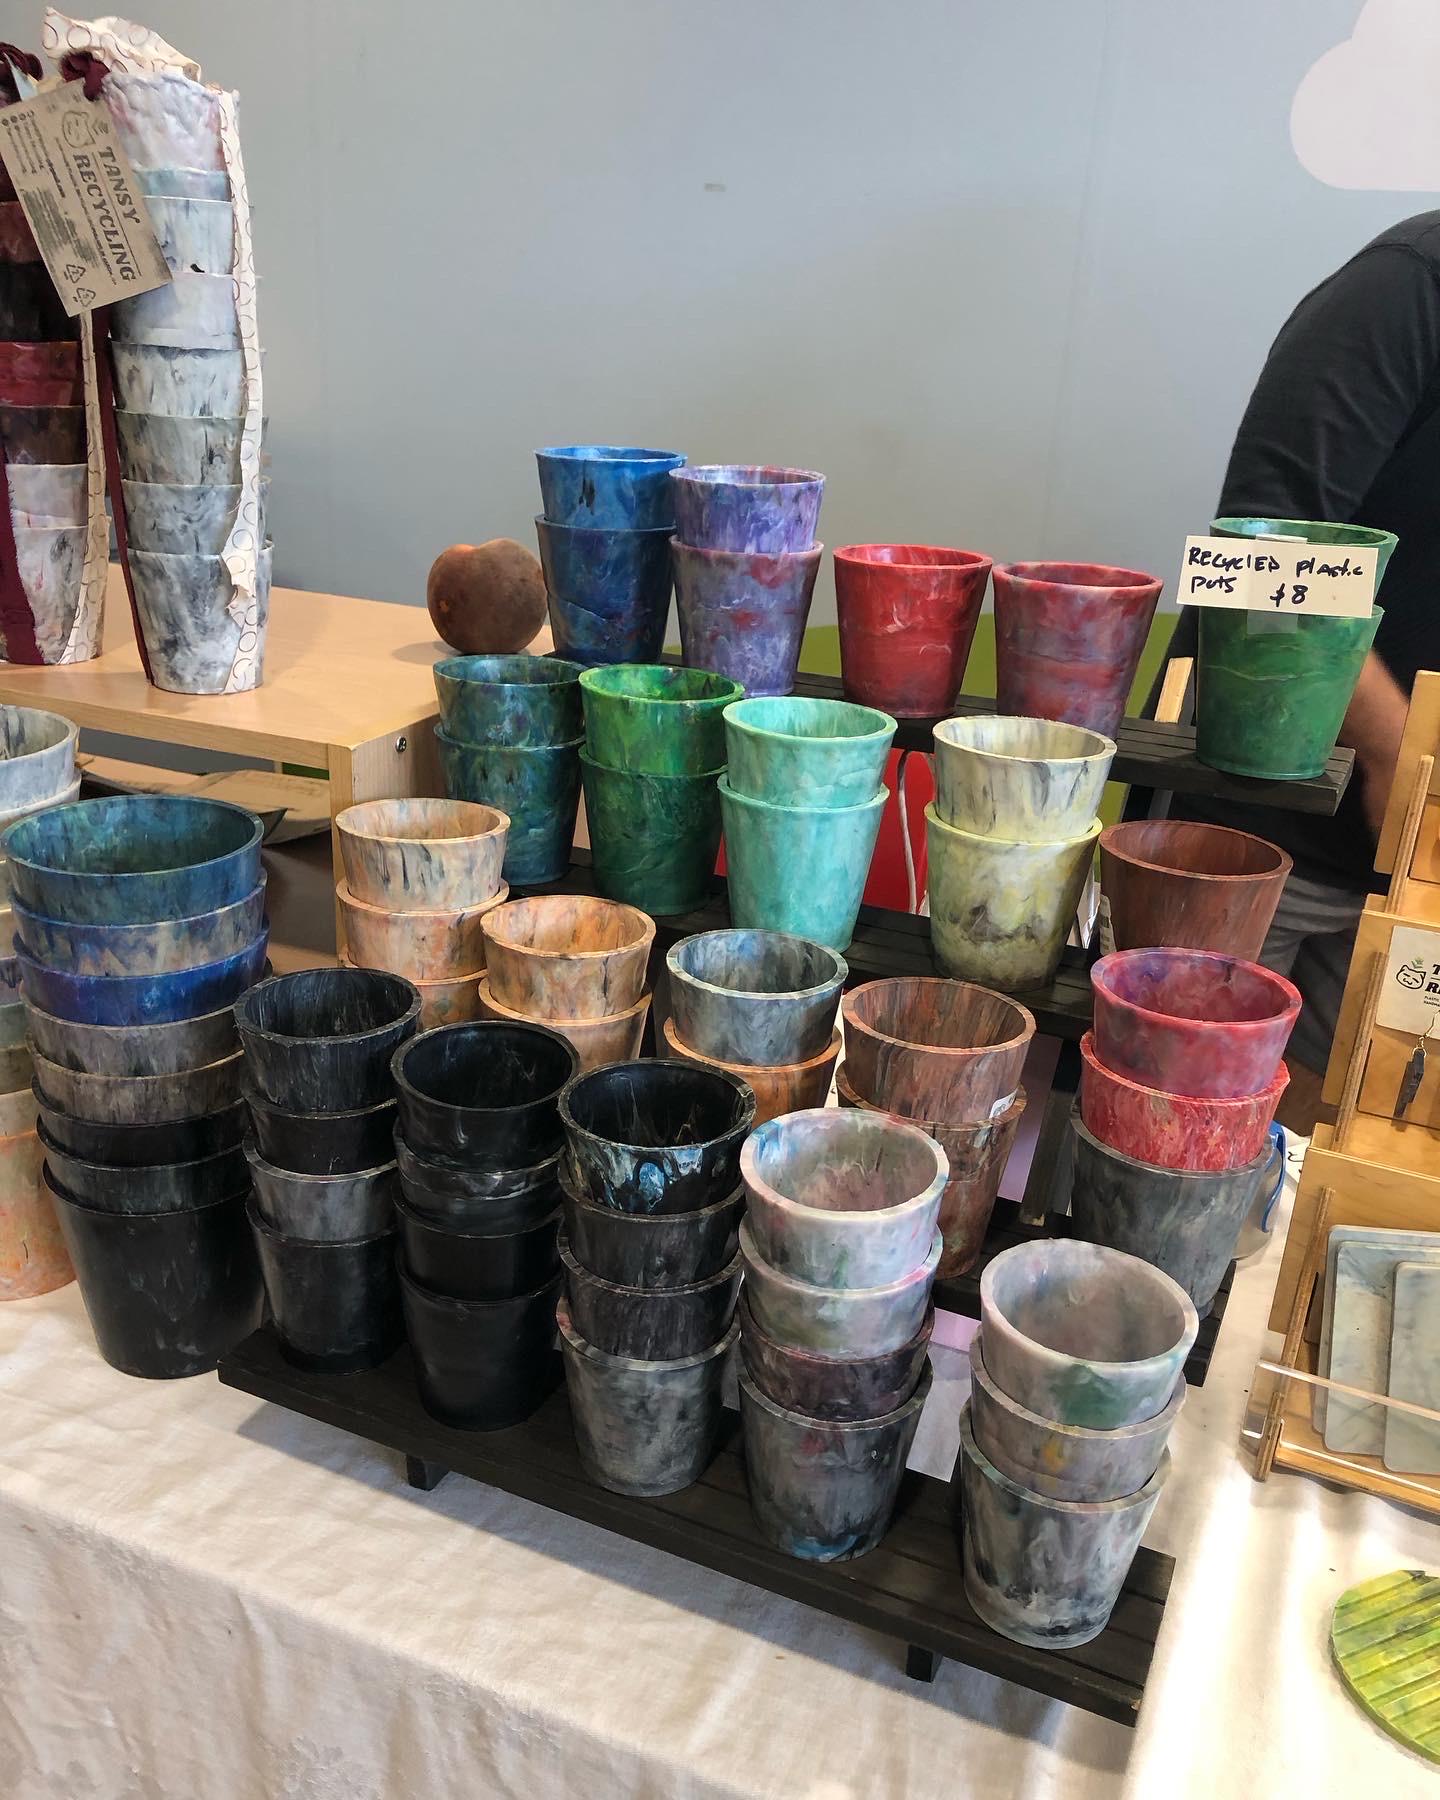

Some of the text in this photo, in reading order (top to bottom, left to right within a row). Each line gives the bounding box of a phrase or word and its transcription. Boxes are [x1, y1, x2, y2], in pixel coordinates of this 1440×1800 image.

[72, 153, 137, 282] RECYCLING
[98, 145, 141, 224] TANSY
[1270, 583, 1308, 607] $8
